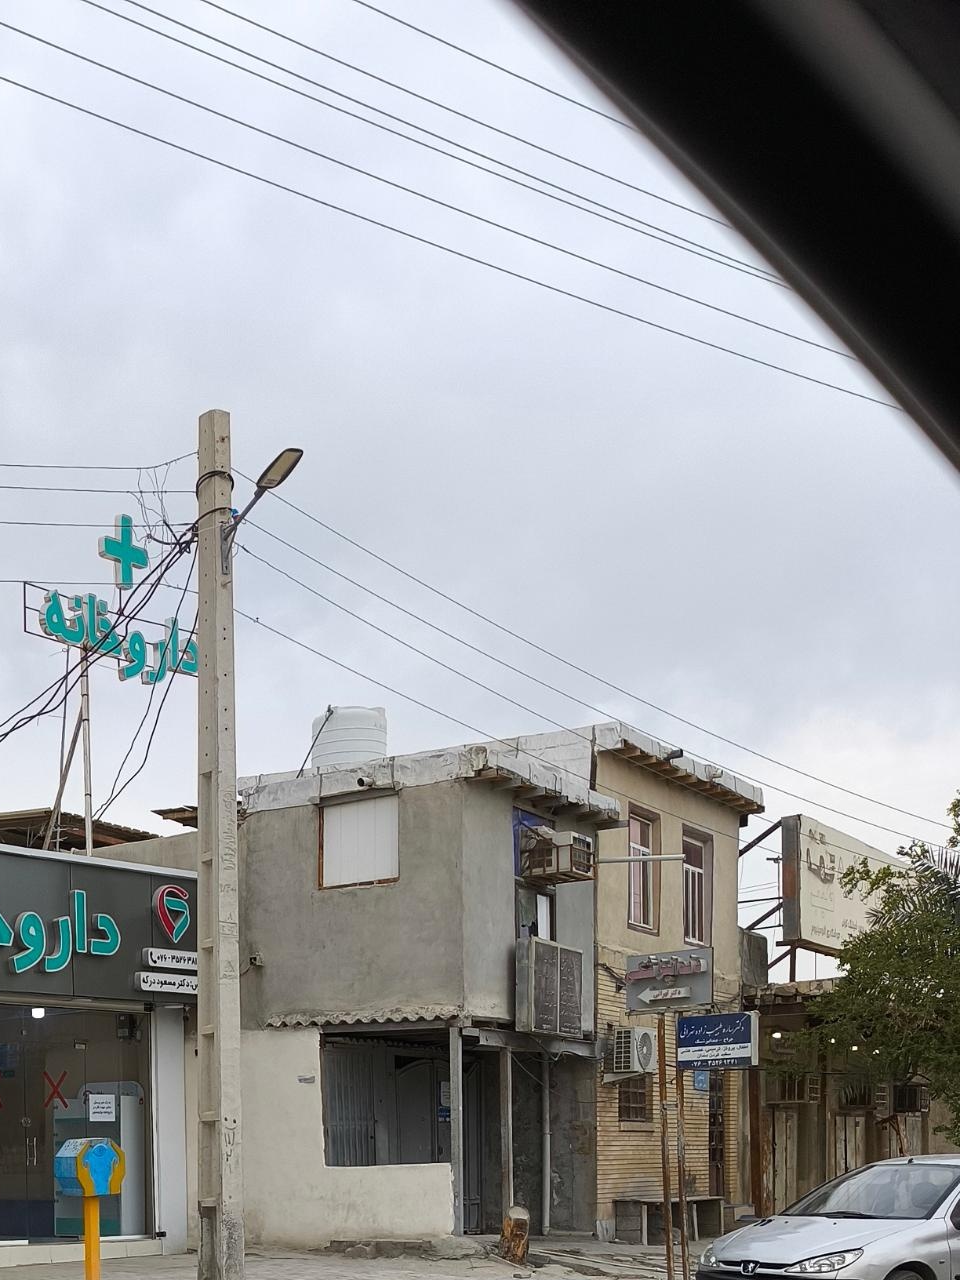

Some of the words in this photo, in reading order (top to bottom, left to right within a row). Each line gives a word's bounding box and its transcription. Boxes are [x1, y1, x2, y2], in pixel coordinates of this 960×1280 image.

[40, 589, 198, 685] داروخانه
[157, 979, 176, 988] مسعود
[177, 978, 190, 989] دکتر
[731, 1014, 748, 1035] دکتر
